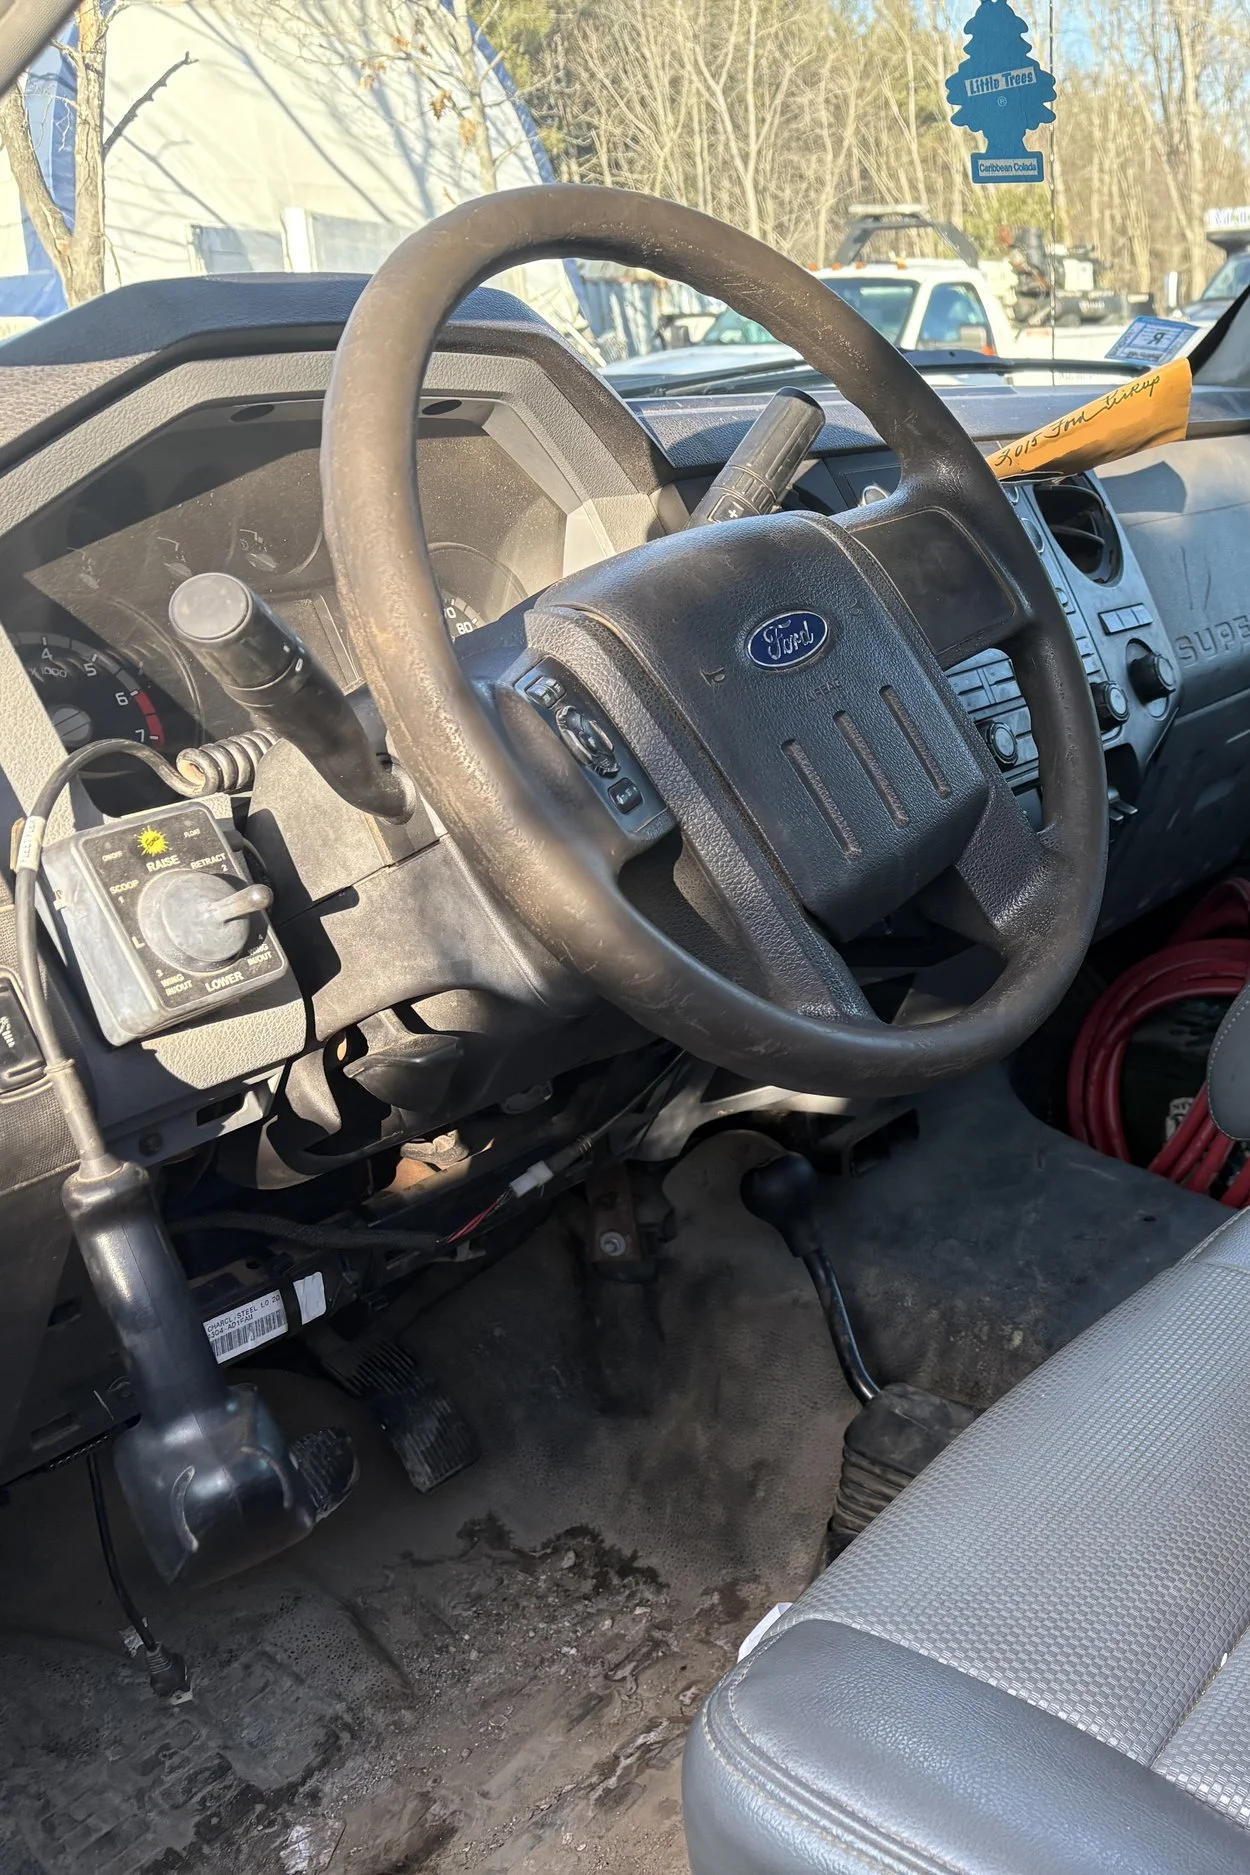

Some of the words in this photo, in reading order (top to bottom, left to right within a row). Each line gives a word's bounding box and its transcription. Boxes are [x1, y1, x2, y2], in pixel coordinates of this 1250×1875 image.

[969, 78, 1000, 95] Little
[1002, 71, 1034, 88] Trees
[979, 163, 1013, 173] Caribbean
[1013, 162, 1037, 172] Colada
[994, 431, 1043, 468] 2015
[1044, 410, 1093, 439] Ford
[456, 621, 474, 635] 80
[762, 618, 815, 661] Ford
[41, 647, 53, 660] 4
[83, 662, 97, 677] 5
[115, 690, 129, 706] 6
[135, 728, 147, 743] 7
[146, 854, 180, 873] RAISE
[190, 852, 227, 870] RETRACT
[109, 879, 140, 895] SCOOP
[118, 896, 124, 904] 1
[132, 936, 145, 949] L
[155, 969, 163, 977] 3
[204, 971, 244, 993] LOWER
